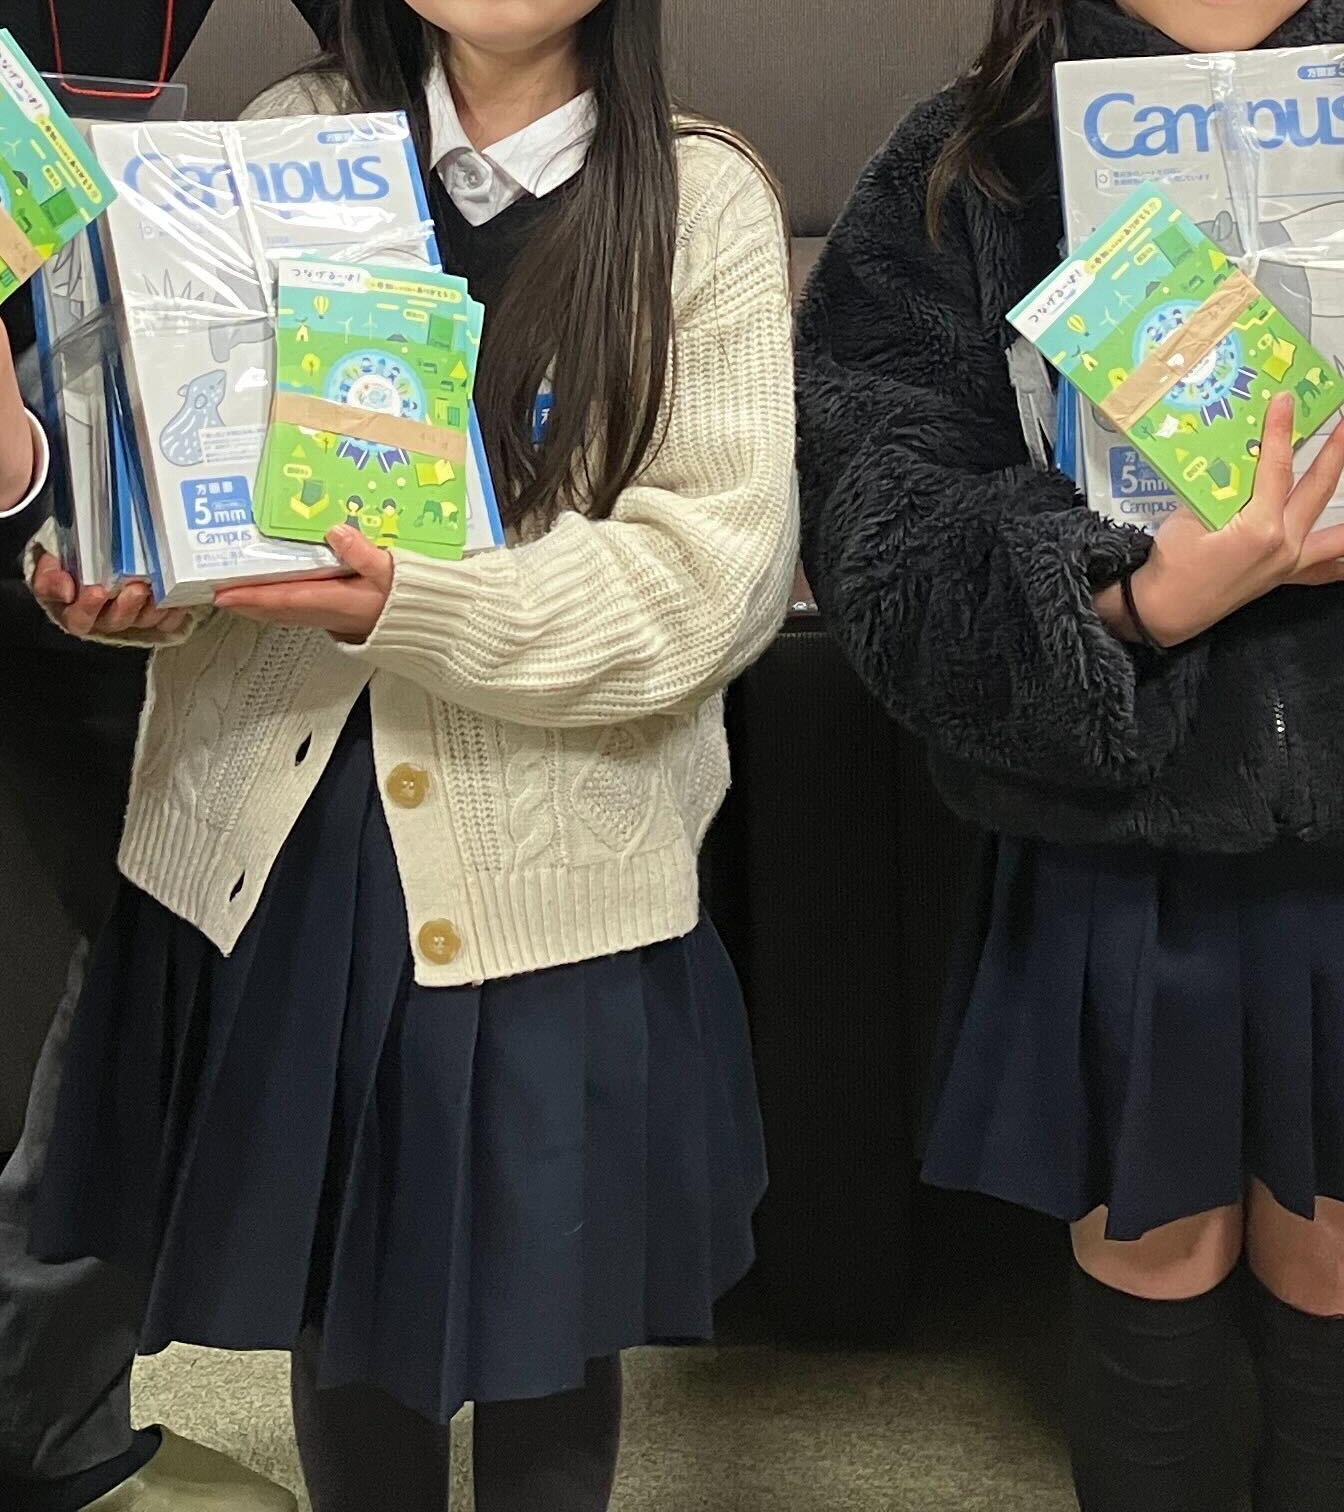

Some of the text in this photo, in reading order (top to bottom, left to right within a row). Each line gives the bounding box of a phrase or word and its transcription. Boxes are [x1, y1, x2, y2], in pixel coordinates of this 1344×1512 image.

[123, 152, 390, 220] Campus
[194, 497, 247, 525] 5mm
[1120, 499, 1178, 515] Campus
[196, 530, 253, 546] Campus
